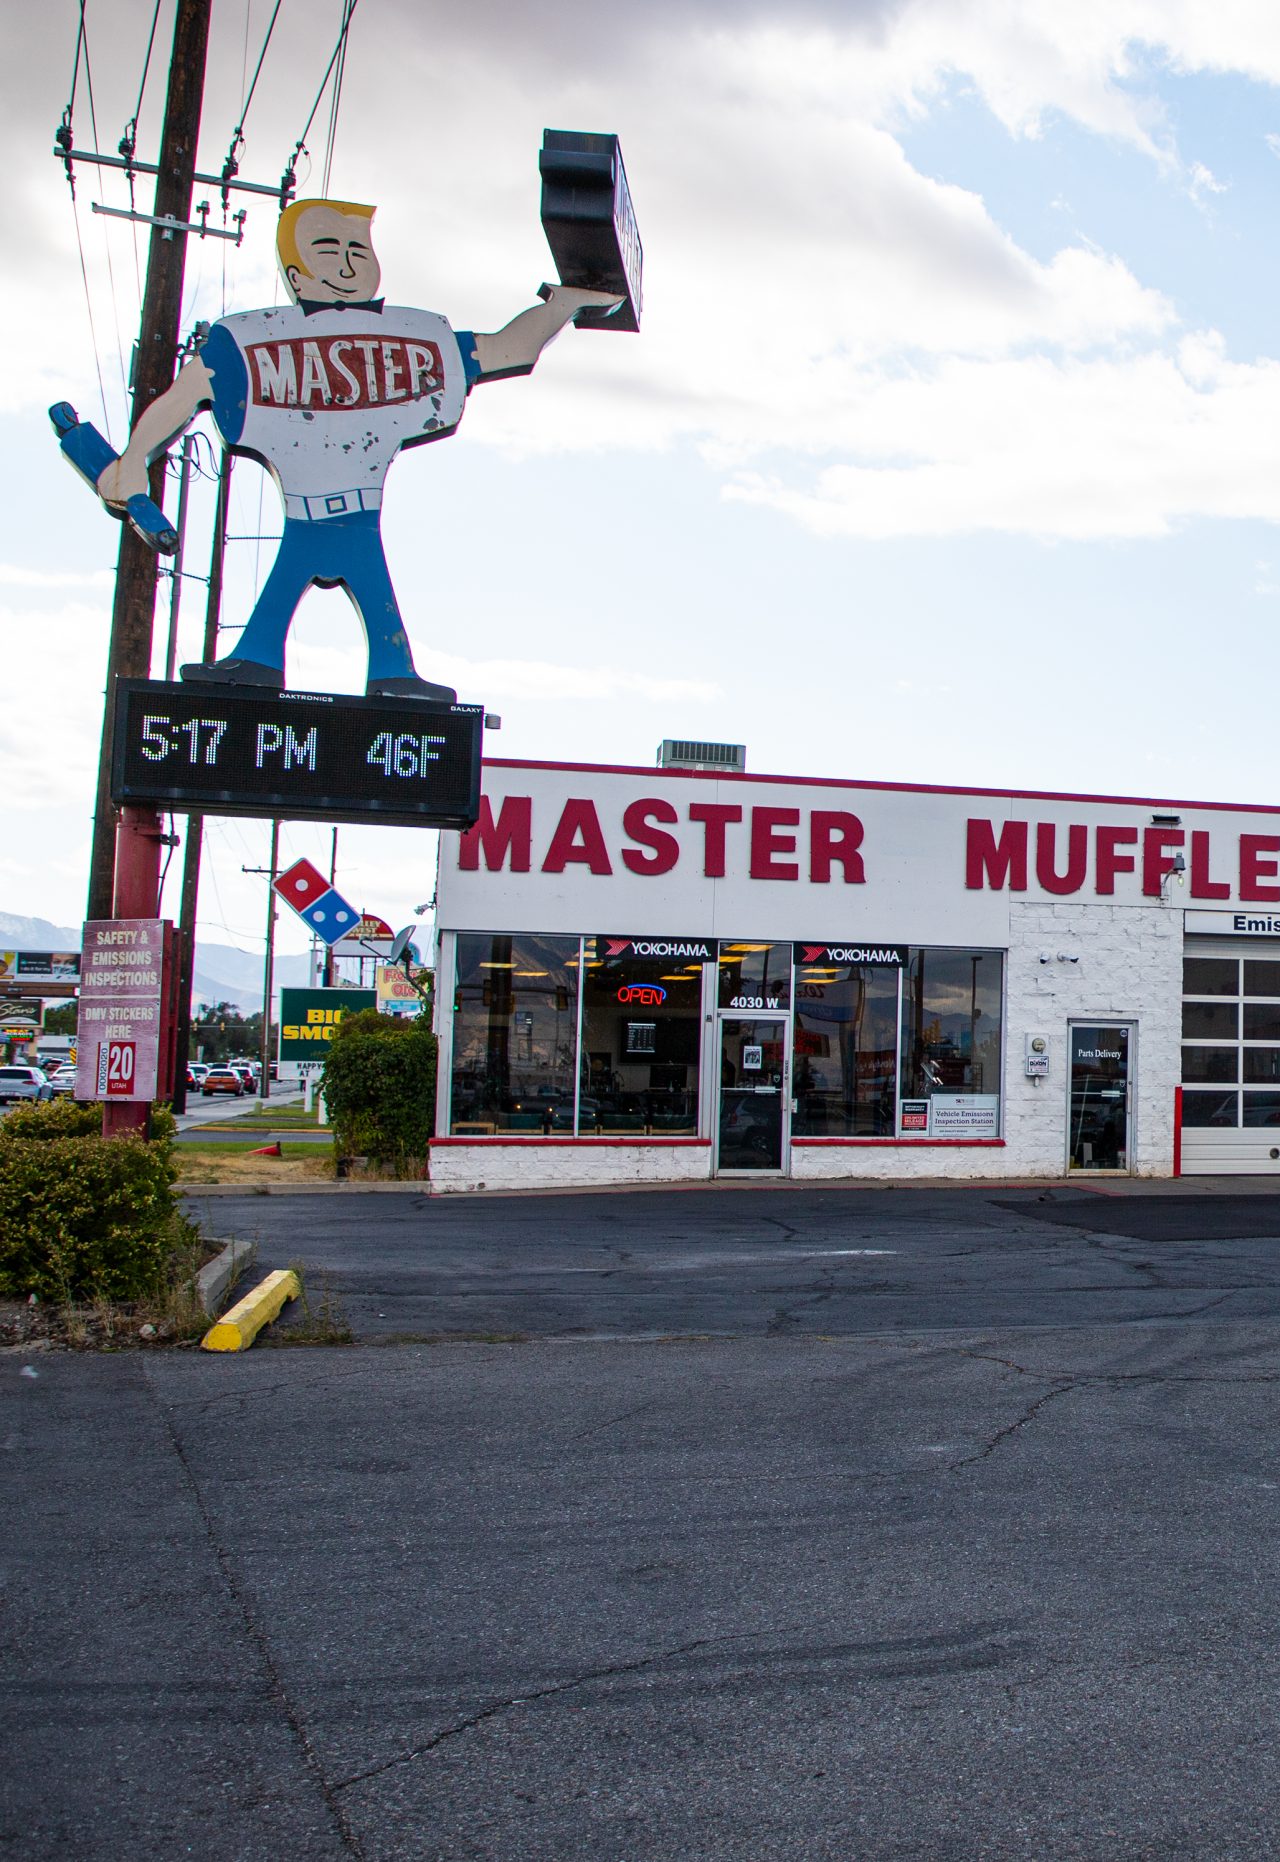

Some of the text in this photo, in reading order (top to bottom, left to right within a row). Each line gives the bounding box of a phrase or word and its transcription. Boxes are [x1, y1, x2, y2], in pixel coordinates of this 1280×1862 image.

[252, 340, 439, 409] MASTER
[279, 692, 333, 703] DAKTRONICS
[450, 705, 480, 713] GALAXY
[141, 715, 446, 778] 5:17 PM 46F
[458, 795, 867, 884] MASTER
[97, 930, 148, 945] SAFETY &
[92, 951, 152, 966] EMISSIONS
[85, 971, 157, 986] INSPECTIONS
[617, 986, 663, 1005] OPEN
[730, 996, 763, 1009] 4030
[85, 1007, 153, 1020] DMV STICKERS
[105, 1025, 132, 1038] HERE
[282, 1025, 335, 1041] SMO
[1078, 1049, 1122, 1060] Parts Delivery
[109, 1046, 133, 1081] 20
